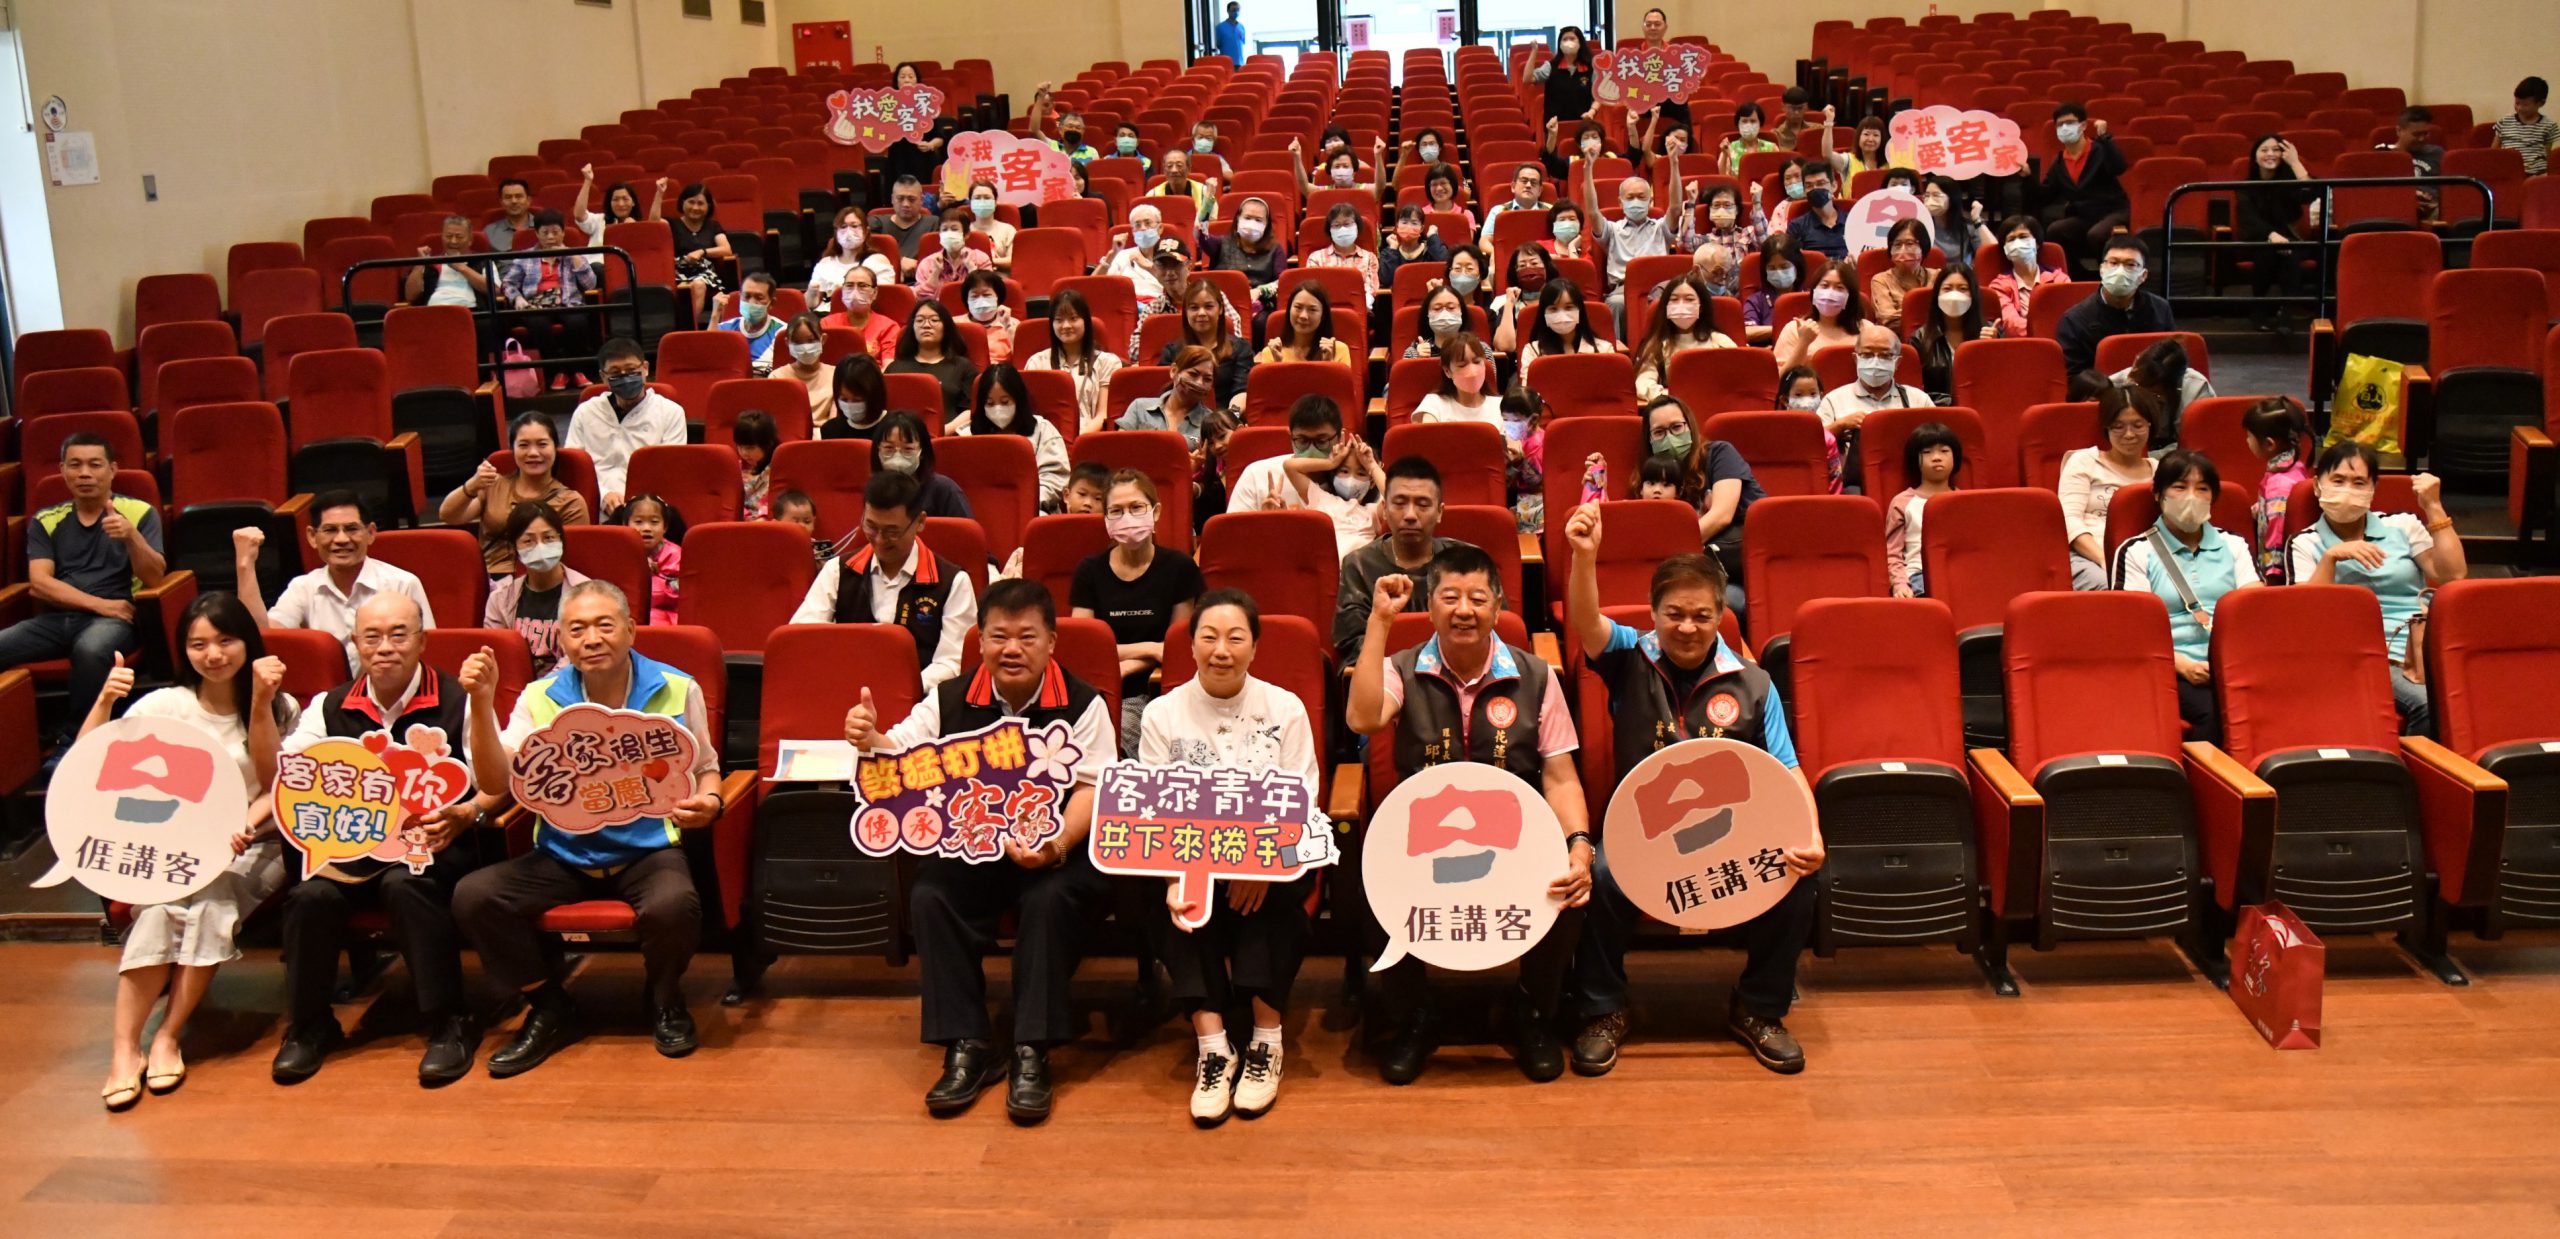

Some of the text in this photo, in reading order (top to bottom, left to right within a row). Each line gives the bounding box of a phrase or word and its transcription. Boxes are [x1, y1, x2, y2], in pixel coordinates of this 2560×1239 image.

[1616, 50, 1702, 93] 我愛客家
[852, 90, 937, 132] 我愛客家
[281, 753, 449, 809] 客家有你
[1104, 766, 1301, 817] 客家青年
